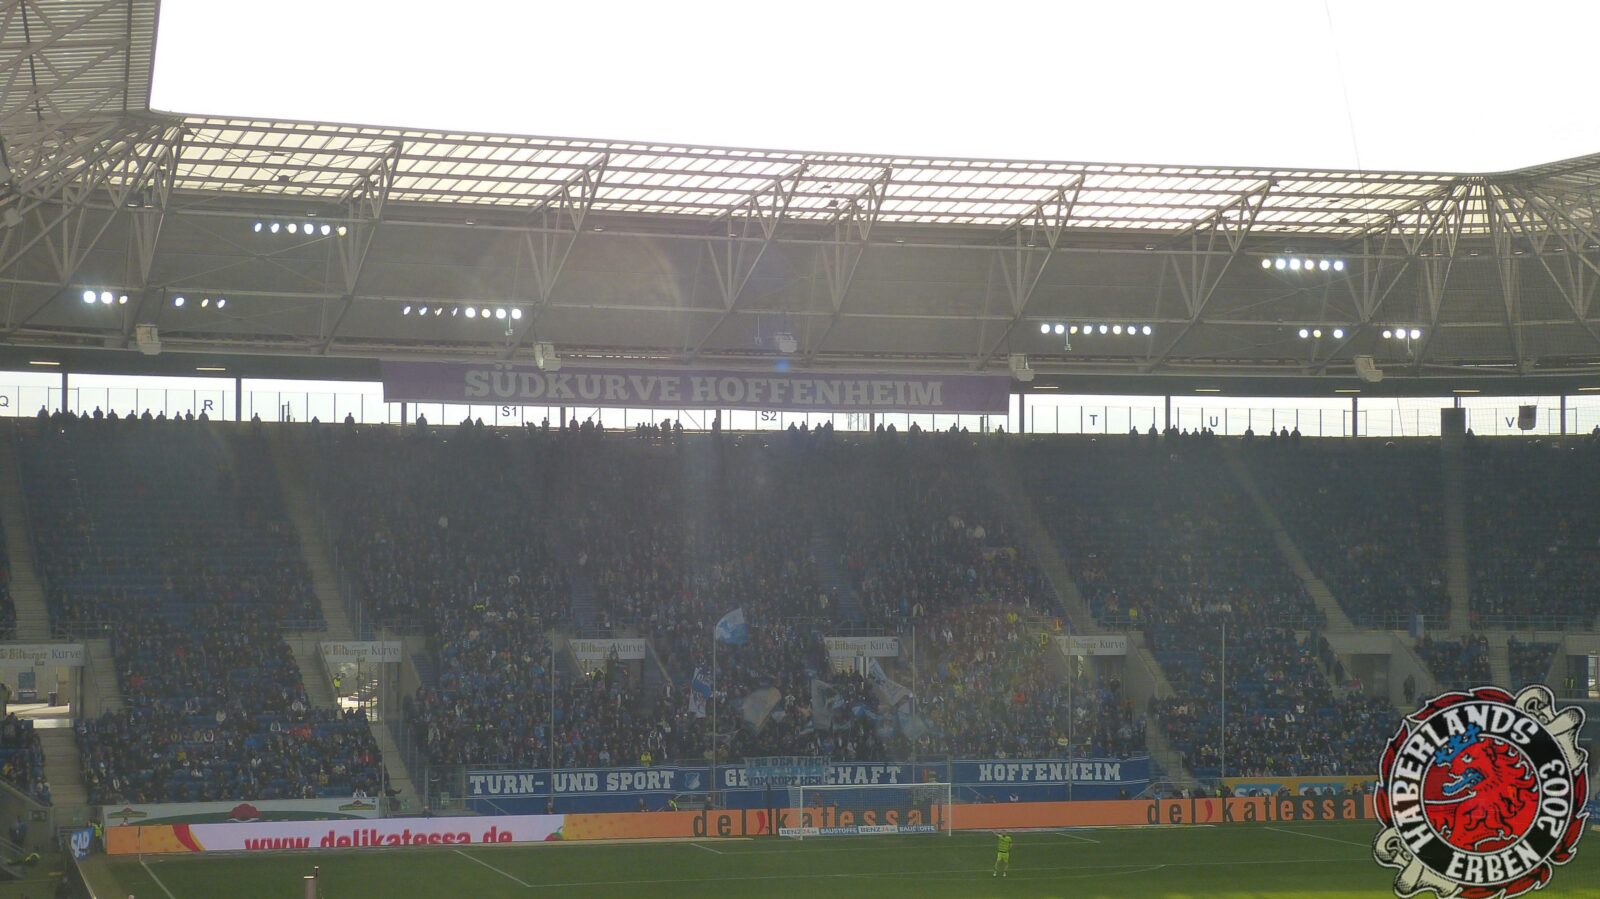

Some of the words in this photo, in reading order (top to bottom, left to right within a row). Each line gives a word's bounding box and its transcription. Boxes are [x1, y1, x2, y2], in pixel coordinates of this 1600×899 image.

[464, 362, 682, 401] SÜDKURVE
[690, 376, 943, 406] HOFFENHEIM
[203, 399, 214, 411] R
[501, 406, 518, 417] S1
[761, 411, 777, 421] S2
[1089, 414, 1098, 426] T
[1210, 416, 1219, 427] U
[1505, 416, 1515, 428] V
[1100, 639, 1126, 649] Kurve
[52, 648, 81, 659] Kurve
[371, 645, 399, 656] Kurve
[978, 762, 1122, 782] HOFFENHEIM
[469, 774, 545, 795] TURN-
[552, 771, 599, 792] UND
[606, 769, 675, 791] SPORT
[244, 825, 513, 849] wwwdelikatessade
